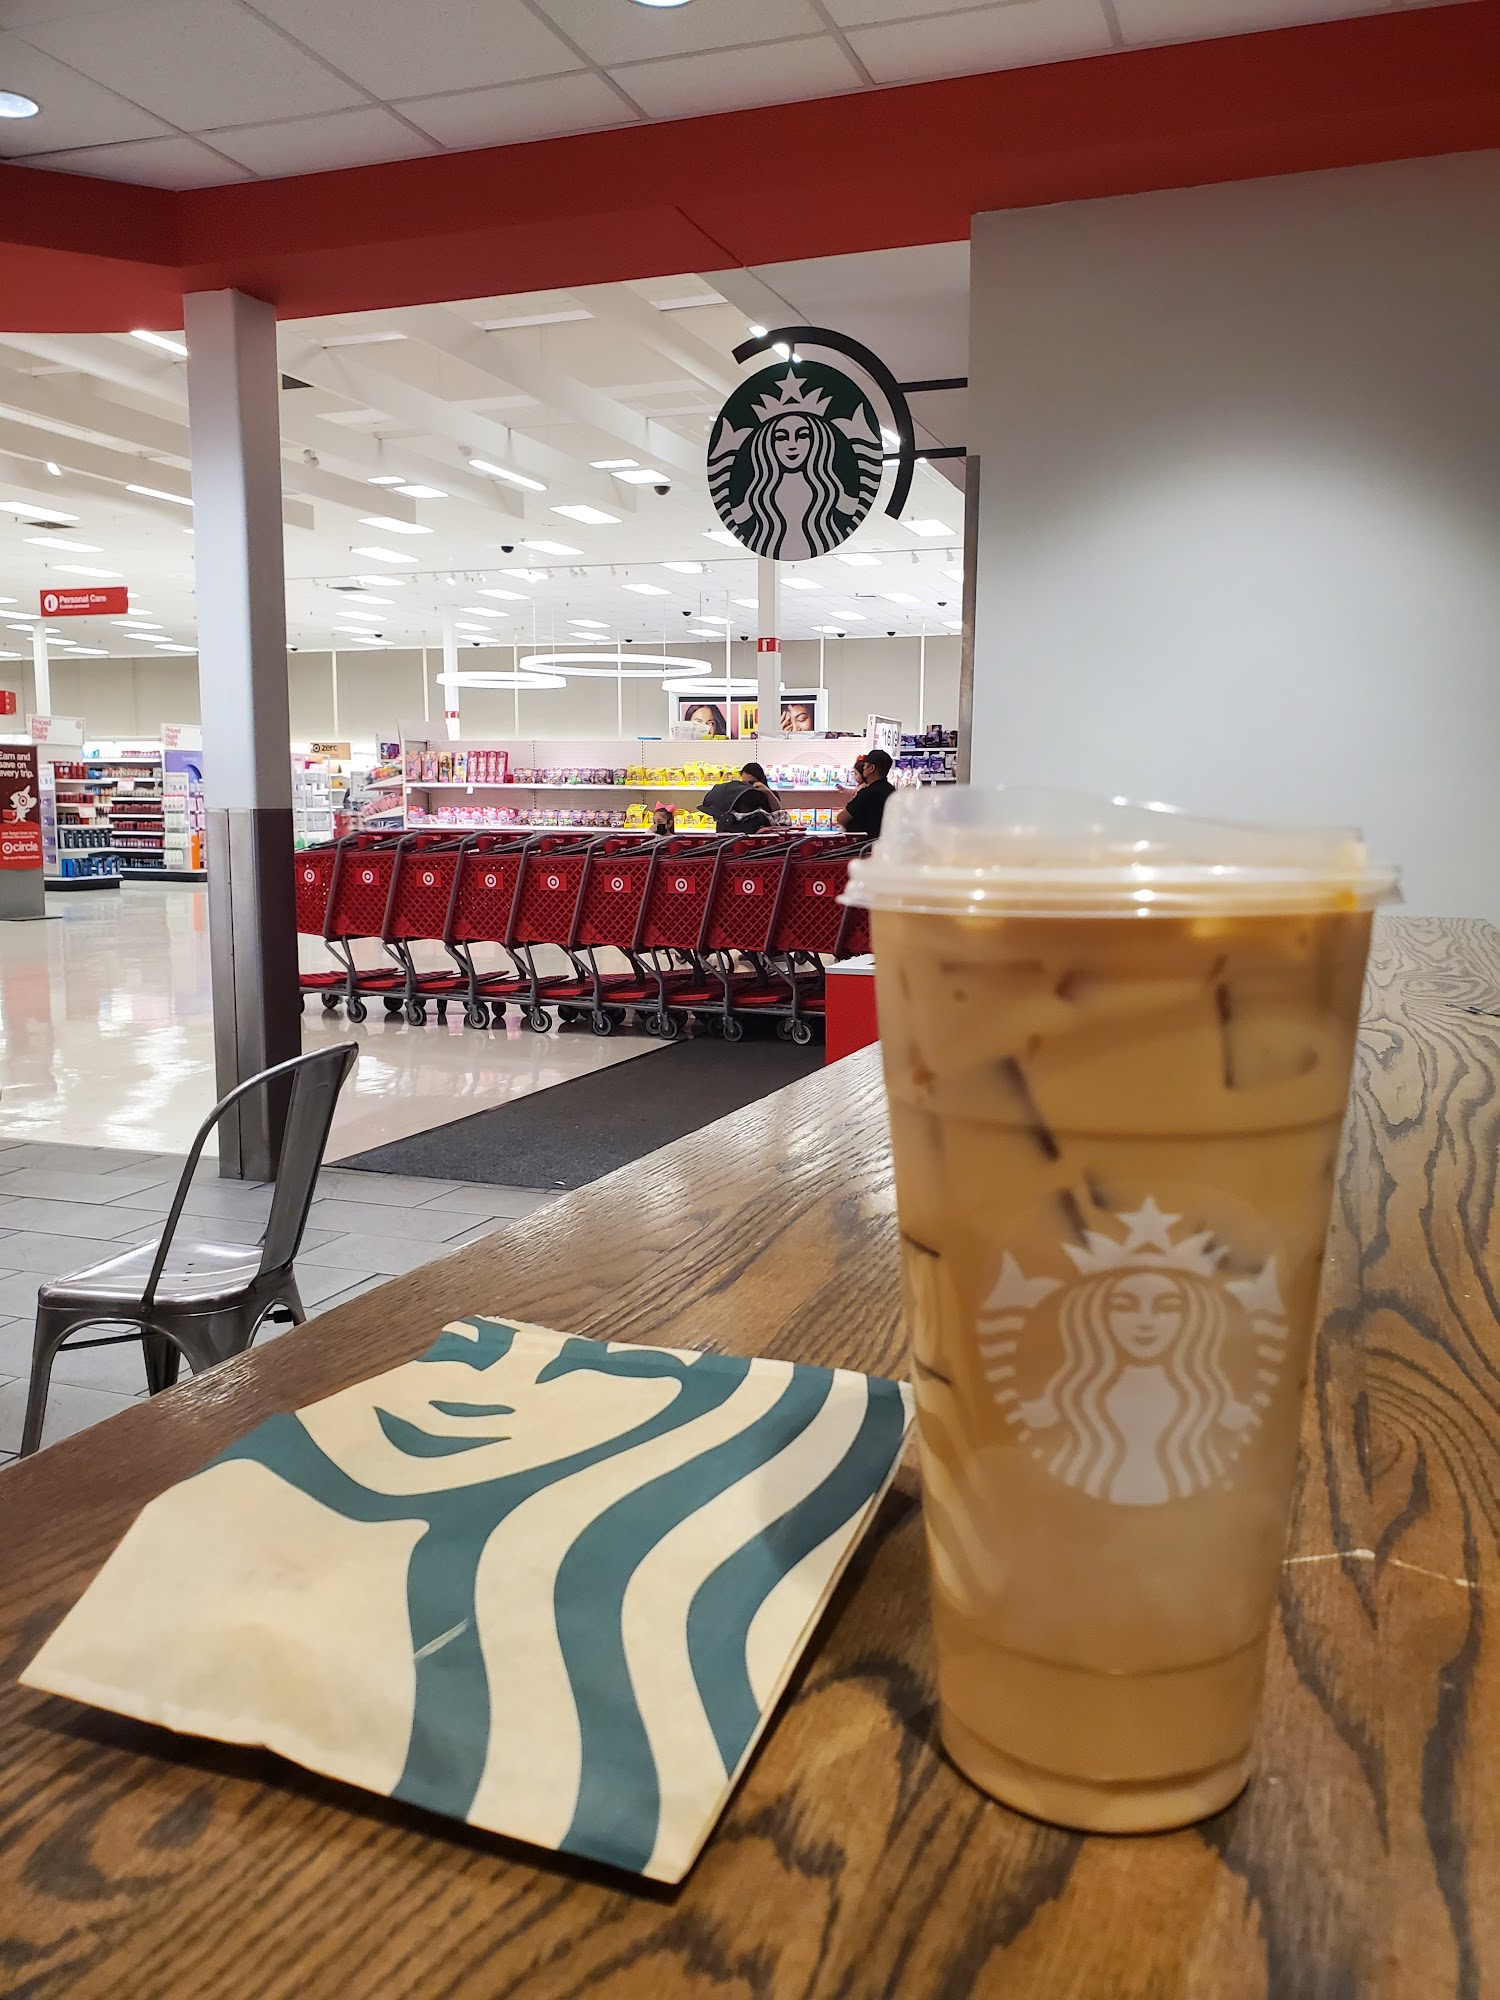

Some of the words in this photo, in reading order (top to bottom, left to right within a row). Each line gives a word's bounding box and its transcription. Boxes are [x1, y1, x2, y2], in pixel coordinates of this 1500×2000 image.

[59, 595, 89, 603] Personal
[89, 593, 107, 602] Care
[32, 718, 51, 726] Priced
[32, 725, 48, 733] Right
[32, 732, 48, 741] Daily
[0, 751, 15, 760] Earn
[16, 752, 31, 761] and
[0, 761, 16, 769] save
[0, 770, 19, 779] every
[20, 769, 34, 779] trip.
[13, 841, 39, 852] circle
